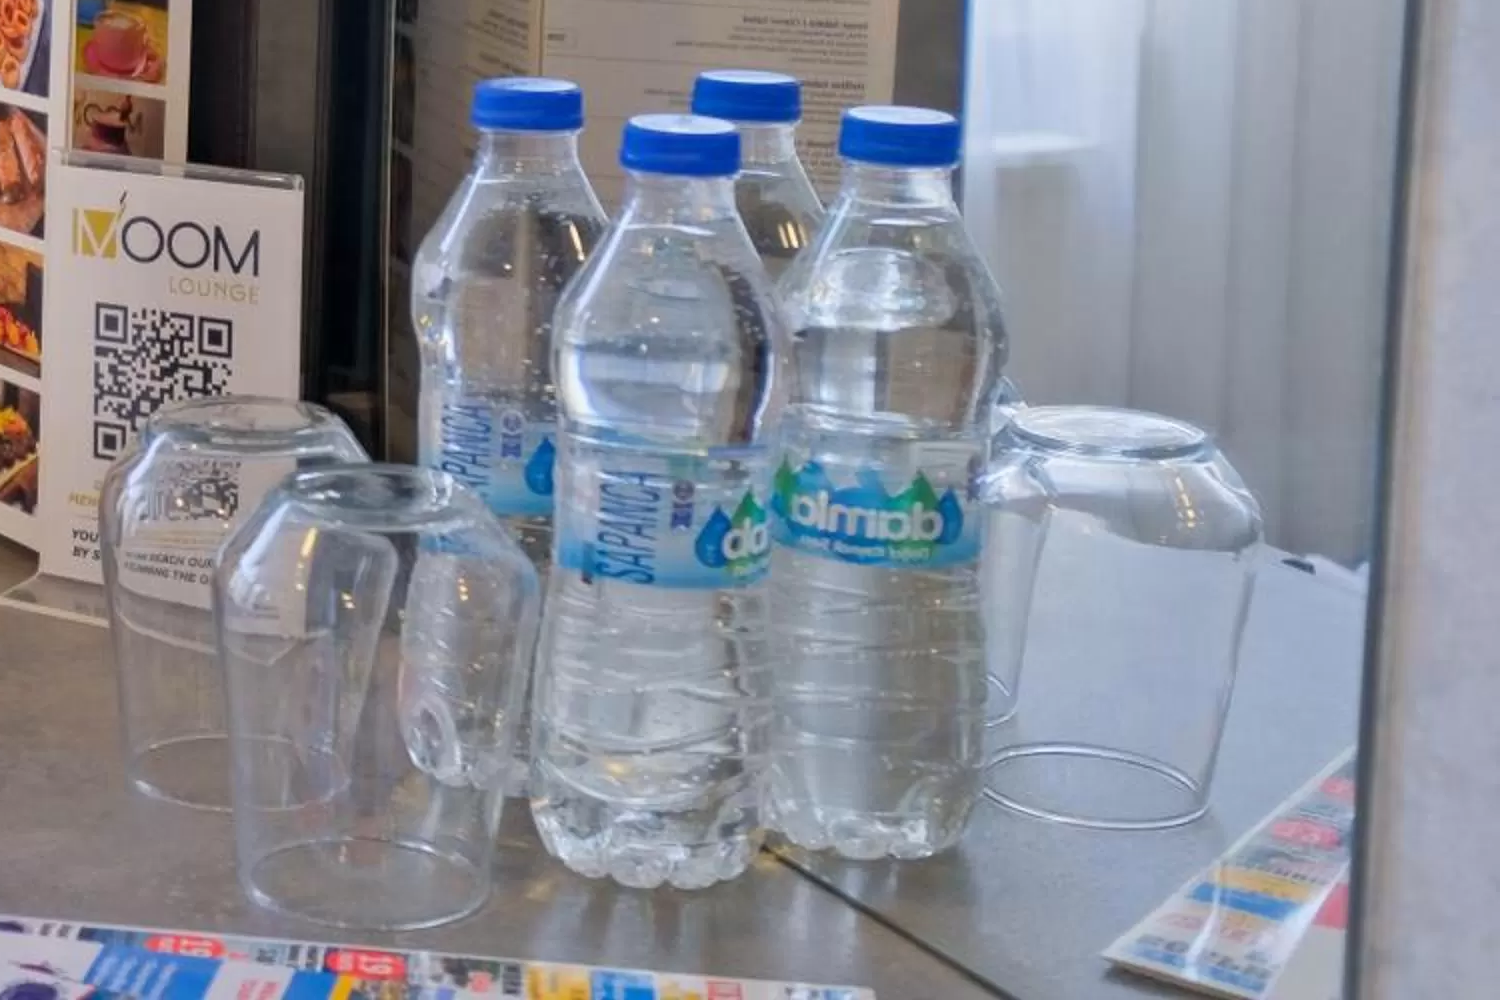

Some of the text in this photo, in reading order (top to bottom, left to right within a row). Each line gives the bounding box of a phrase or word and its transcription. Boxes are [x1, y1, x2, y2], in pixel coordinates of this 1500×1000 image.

[72, 204, 261, 277] MOOM
[169, 276, 260, 305] LOUNGE
[594, 469, 661, 585] SAPANCA
